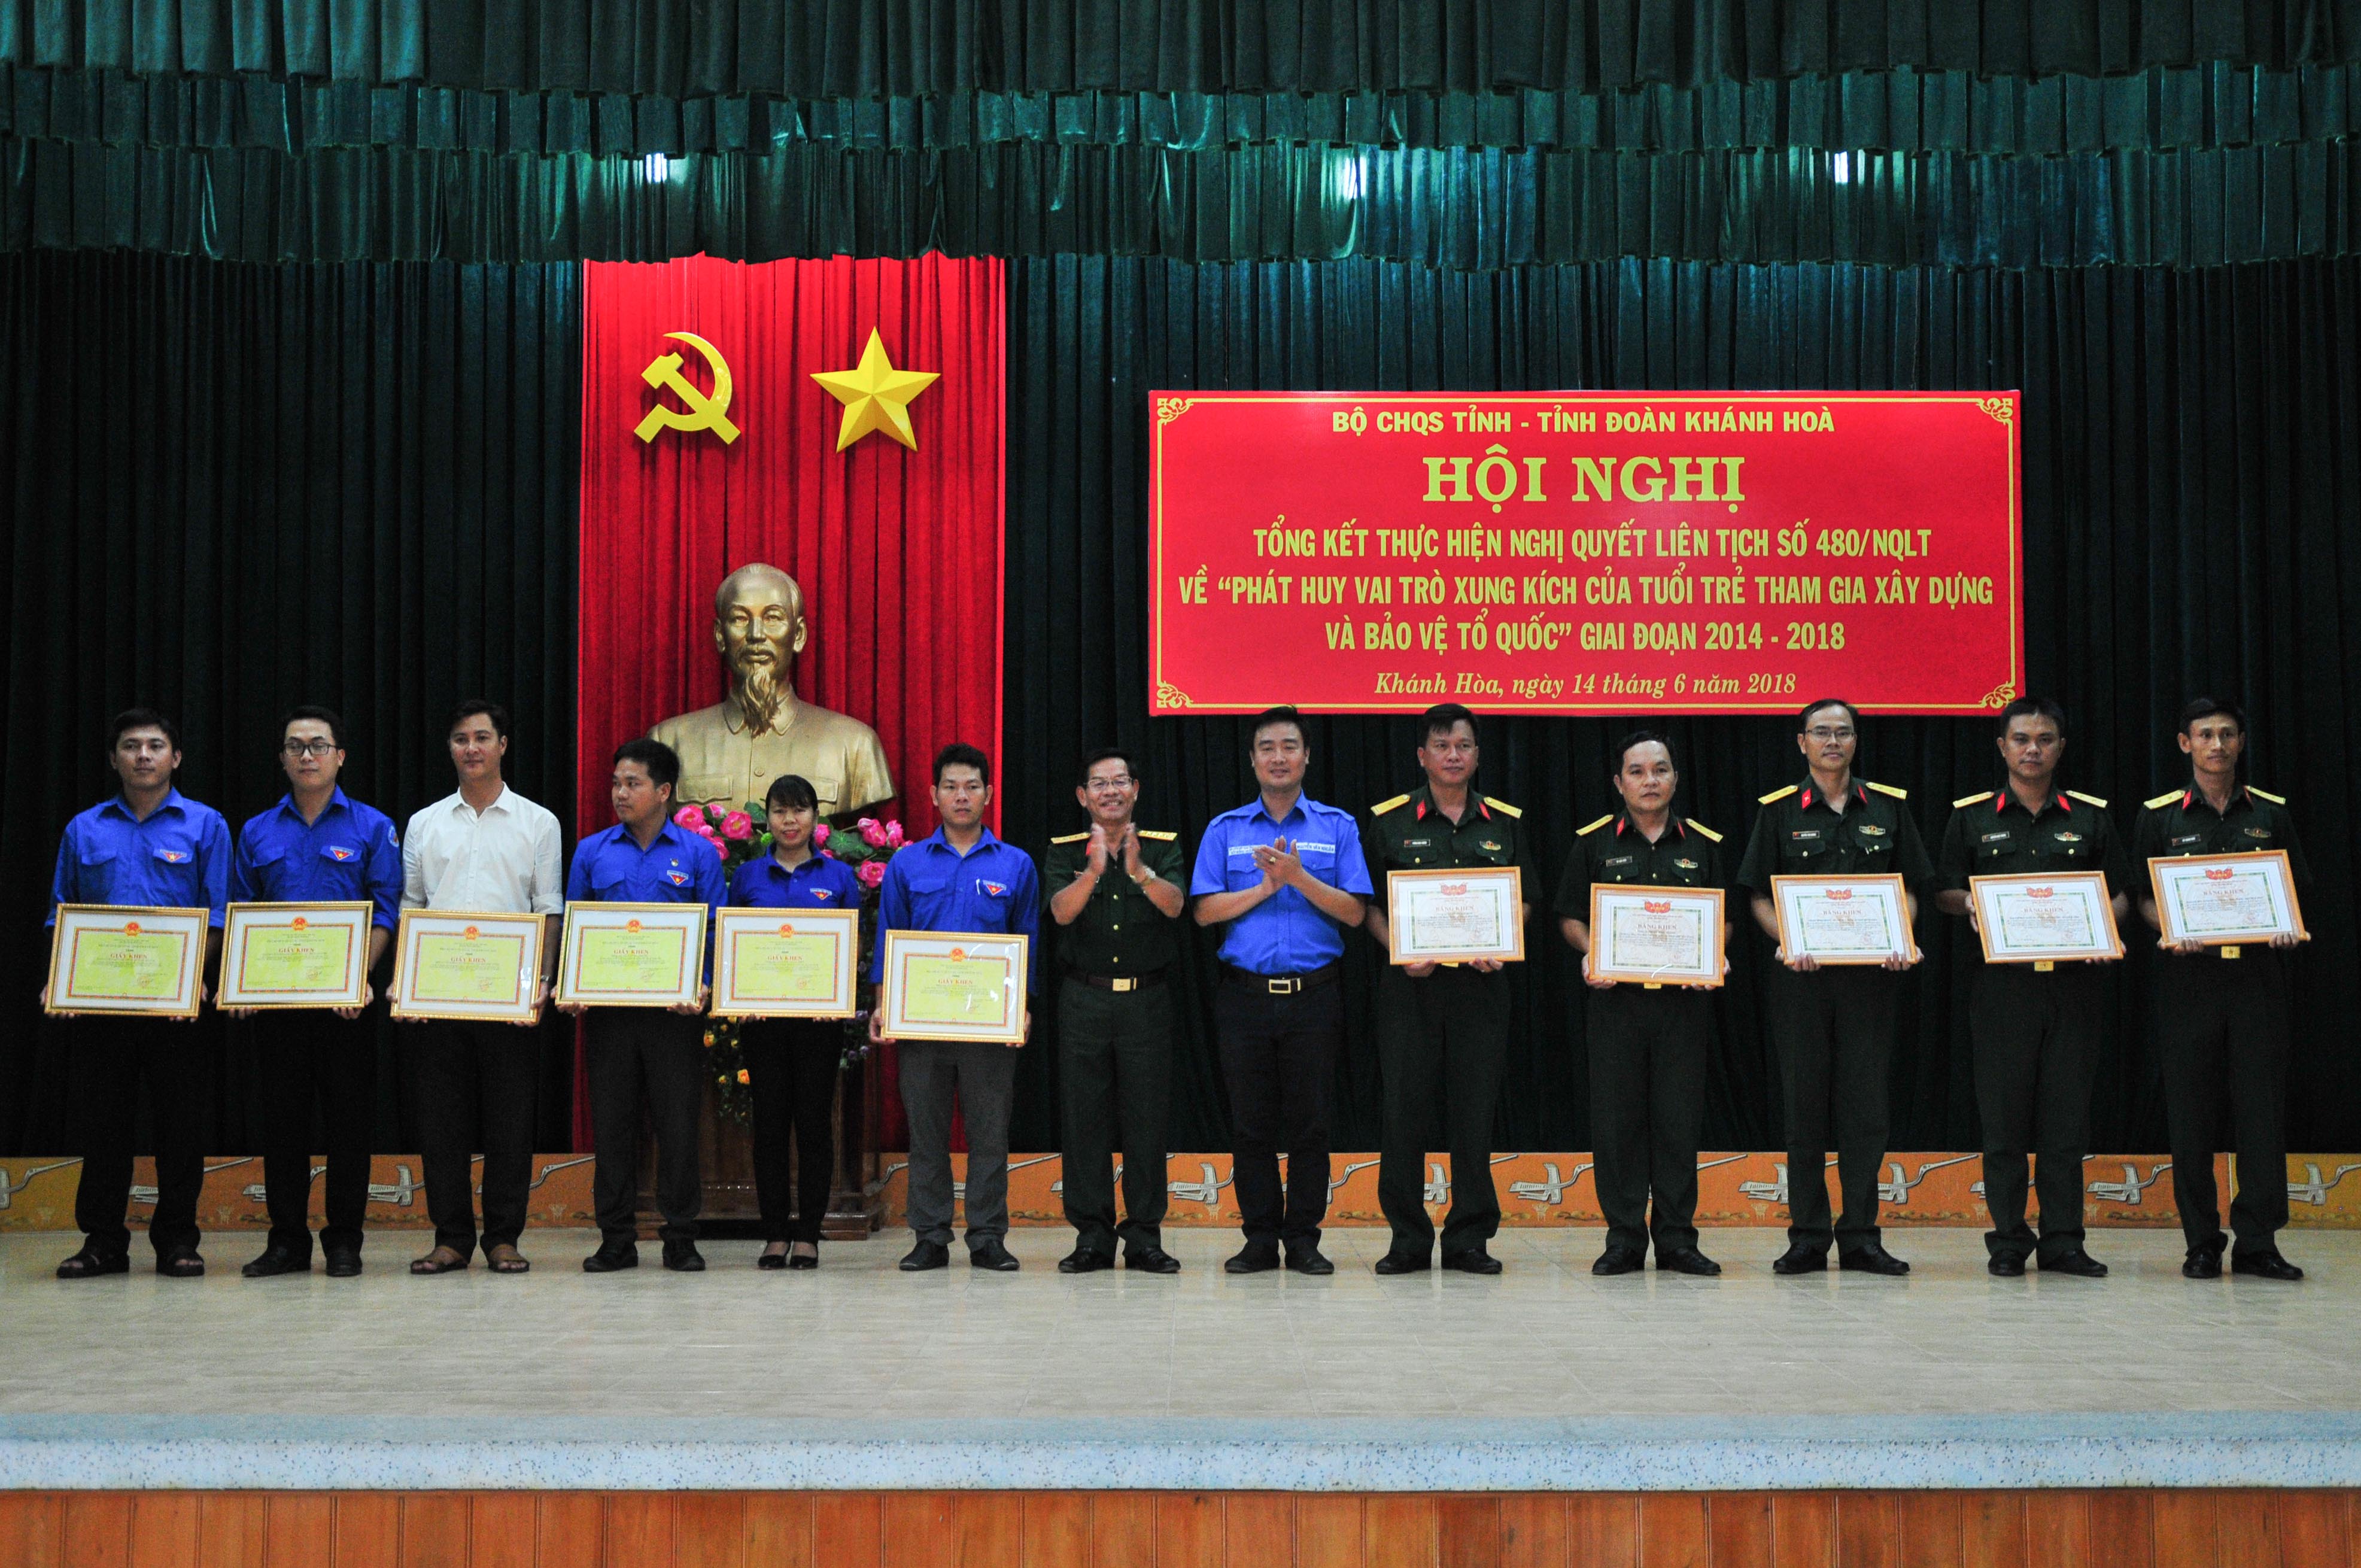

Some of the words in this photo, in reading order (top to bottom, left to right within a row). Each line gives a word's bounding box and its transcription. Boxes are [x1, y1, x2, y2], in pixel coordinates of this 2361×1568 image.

[1332, 406, 1368, 437] BỘ
[1377, 411, 1444, 436] CHQS
[1451, 405, 1511, 433] TỈNH
[1536, 405, 1596, 433] TỈNH
[1605, 406, 1676, 433] ĐOÀN
[1685, 406, 1773, 432] KHÁNH
[1783, 406, 1835, 433] HOÀ
[1422, 443, 1547, 513] HỘI
[1571, 456, 1746, 513] NGHỊ
[1253, 515, 1315, 557] TỔNG
[1323, 518, 1369, 557] KẾT
[1376, 524, 1439, 563] THỰC
[1447, 522, 1502, 563] HIỆN
[1510, 529, 1564, 564] NGHỊ
[1571, 518, 1648, 563] QUYẾT
[1655, 521, 1709, 557] LIÊN
[1715, 528, 1769, 563] TỊCH
[1777, 518, 1810, 557] SỐ
[1816, 529, 1932, 562] 480/NQLT
[1178, 564, 1208, 604] VỀ
[1218, 569, 1293, 604] “PHÁT
[1301, 576, 1347, 604] HUY
[1354, 577, 1391, 604] VAI
[1398, 569, 1446, 604] TRÒ
[1454, 576, 1515, 605] XUNG
[1523, 570, 1577, 605] KÍCH
[1585, 566, 1632, 605] CỦA
[1638, 562, 1693, 605] TUỔI
[1700, 566, 1746, 604] TRẺ
[1754, 576, 1821, 604] THAM
[1828, 576, 1867, 604] GIA
[1874, 569, 1921, 604] XÂY
[1929, 572, 1993, 610] DỰNG
[1325, 615, 1356, 650] VÀ
[1365, 612, 1412, 651] BẢO
[1418, 615, 1448, 656] VỆ
[1457, 607, 1489, 651] TỔ
[1496, 612, 1572, 655] QUỐC”
[1580, 622, 1625, 651] GIAI
[1632, 622, 1697, 656] ĐOẠN
[1704, 622, 1763, 651] 2014
[1786, 622, 1845, 650] 2018
[1374, 673, 1447, 694] Khánh
[1454, 673, 1504, 698] Hòa,
[1512, 673, 1564, 699] ngày
[1572, 674, 1596, 694] 14
[1602, 673, 1667, 699] tháng
[1674, 673, 1687, 694] 6
[1692, 674, 1740, 694] năm
[1747, 673, 1796, 694] 2018
